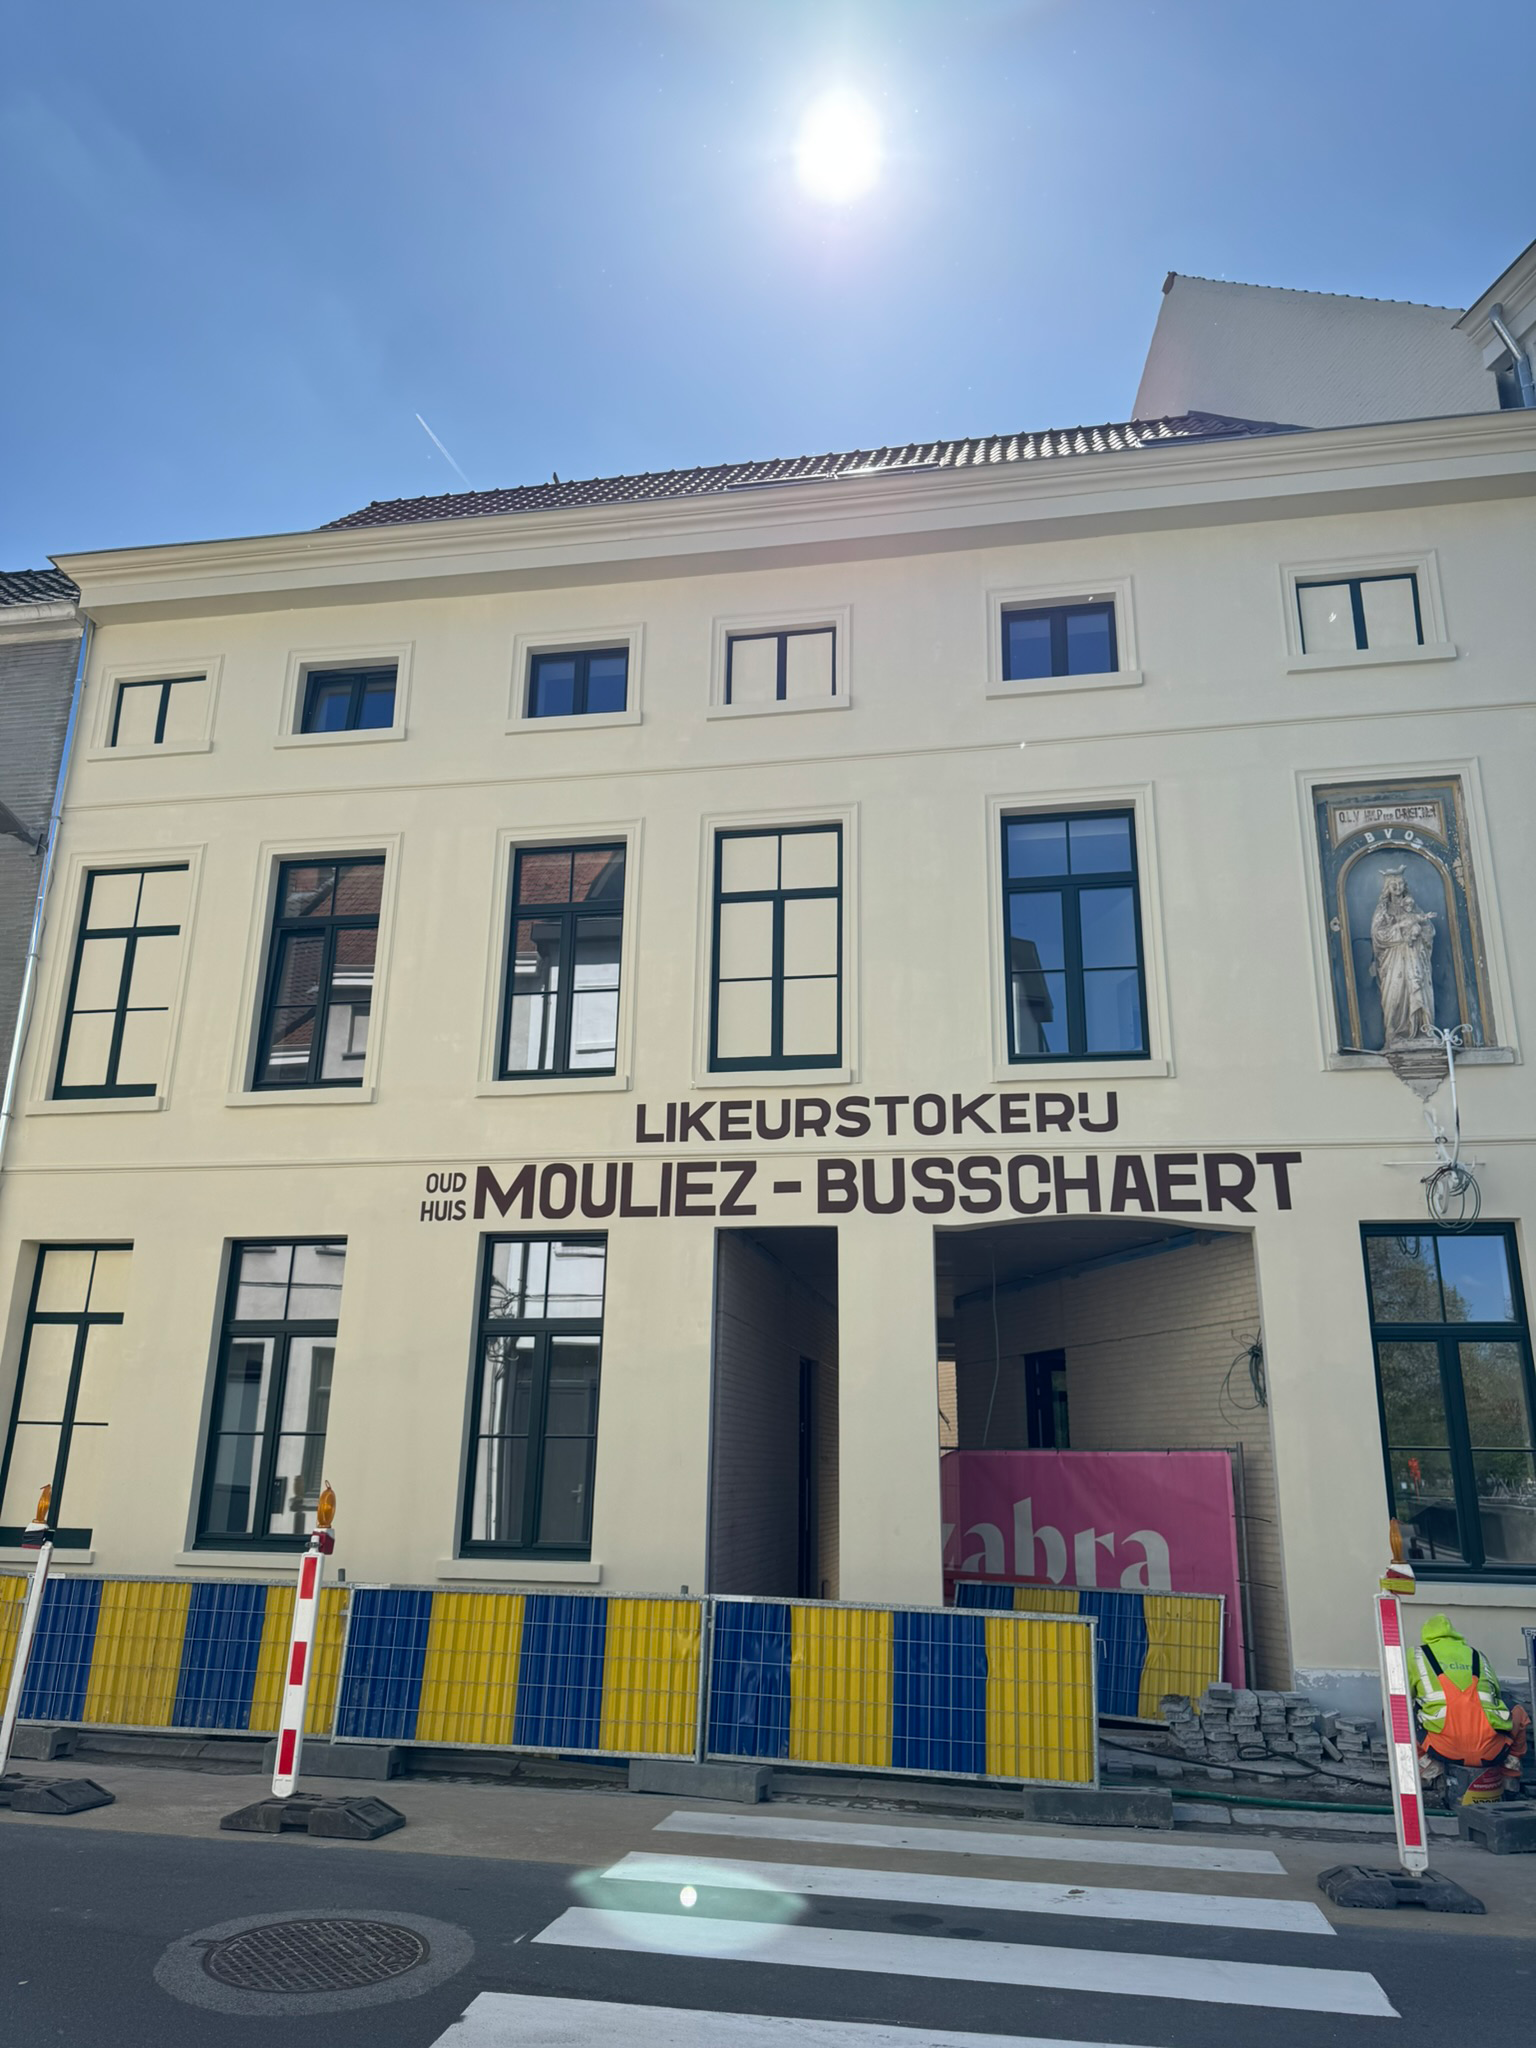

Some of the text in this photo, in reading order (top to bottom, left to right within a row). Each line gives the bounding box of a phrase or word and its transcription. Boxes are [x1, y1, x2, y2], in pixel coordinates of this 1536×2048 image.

[636, 1091, 1119, 1143] LIKEURSTOKERIJ
[426, 1172, 467, 1194] OUD
[473, 1160, 758, 1220] MOULIEZ
[817, 1151, 1302, 1215] BUSSCHAERT
[420, 1199, 467, 1222] HUIS
